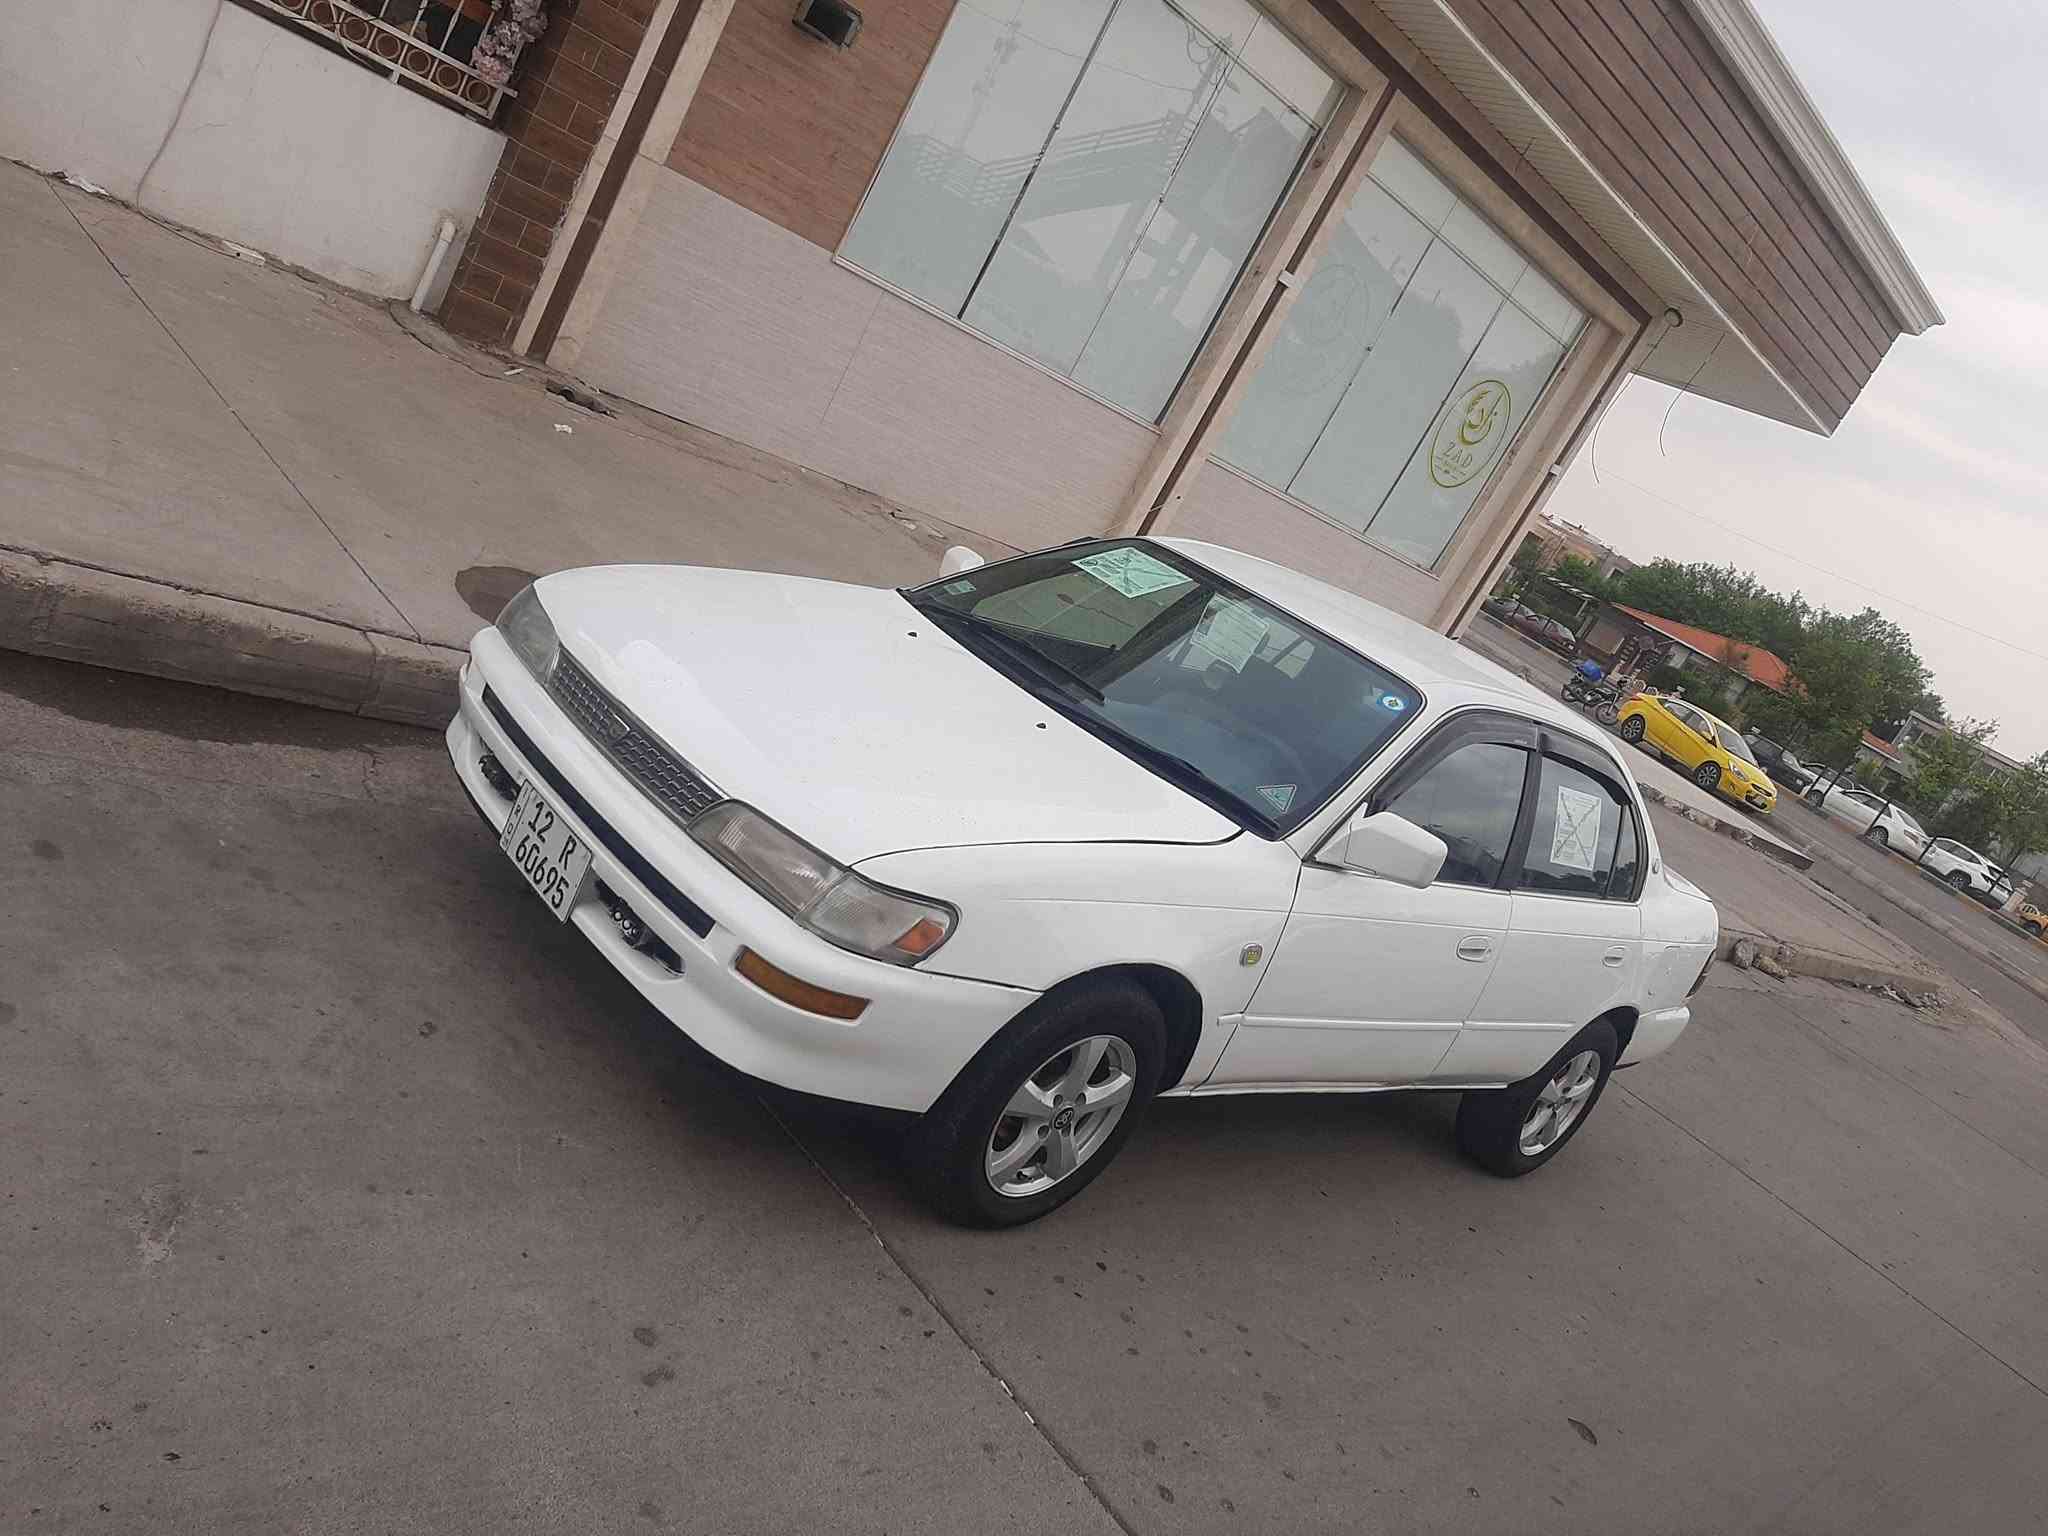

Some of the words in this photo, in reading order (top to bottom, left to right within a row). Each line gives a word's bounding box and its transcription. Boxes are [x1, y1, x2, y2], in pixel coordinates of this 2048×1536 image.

[515, 834, 570, 909] 60695
[527, 801, 555, 843] 12
[559, 834, 577, 870] R
